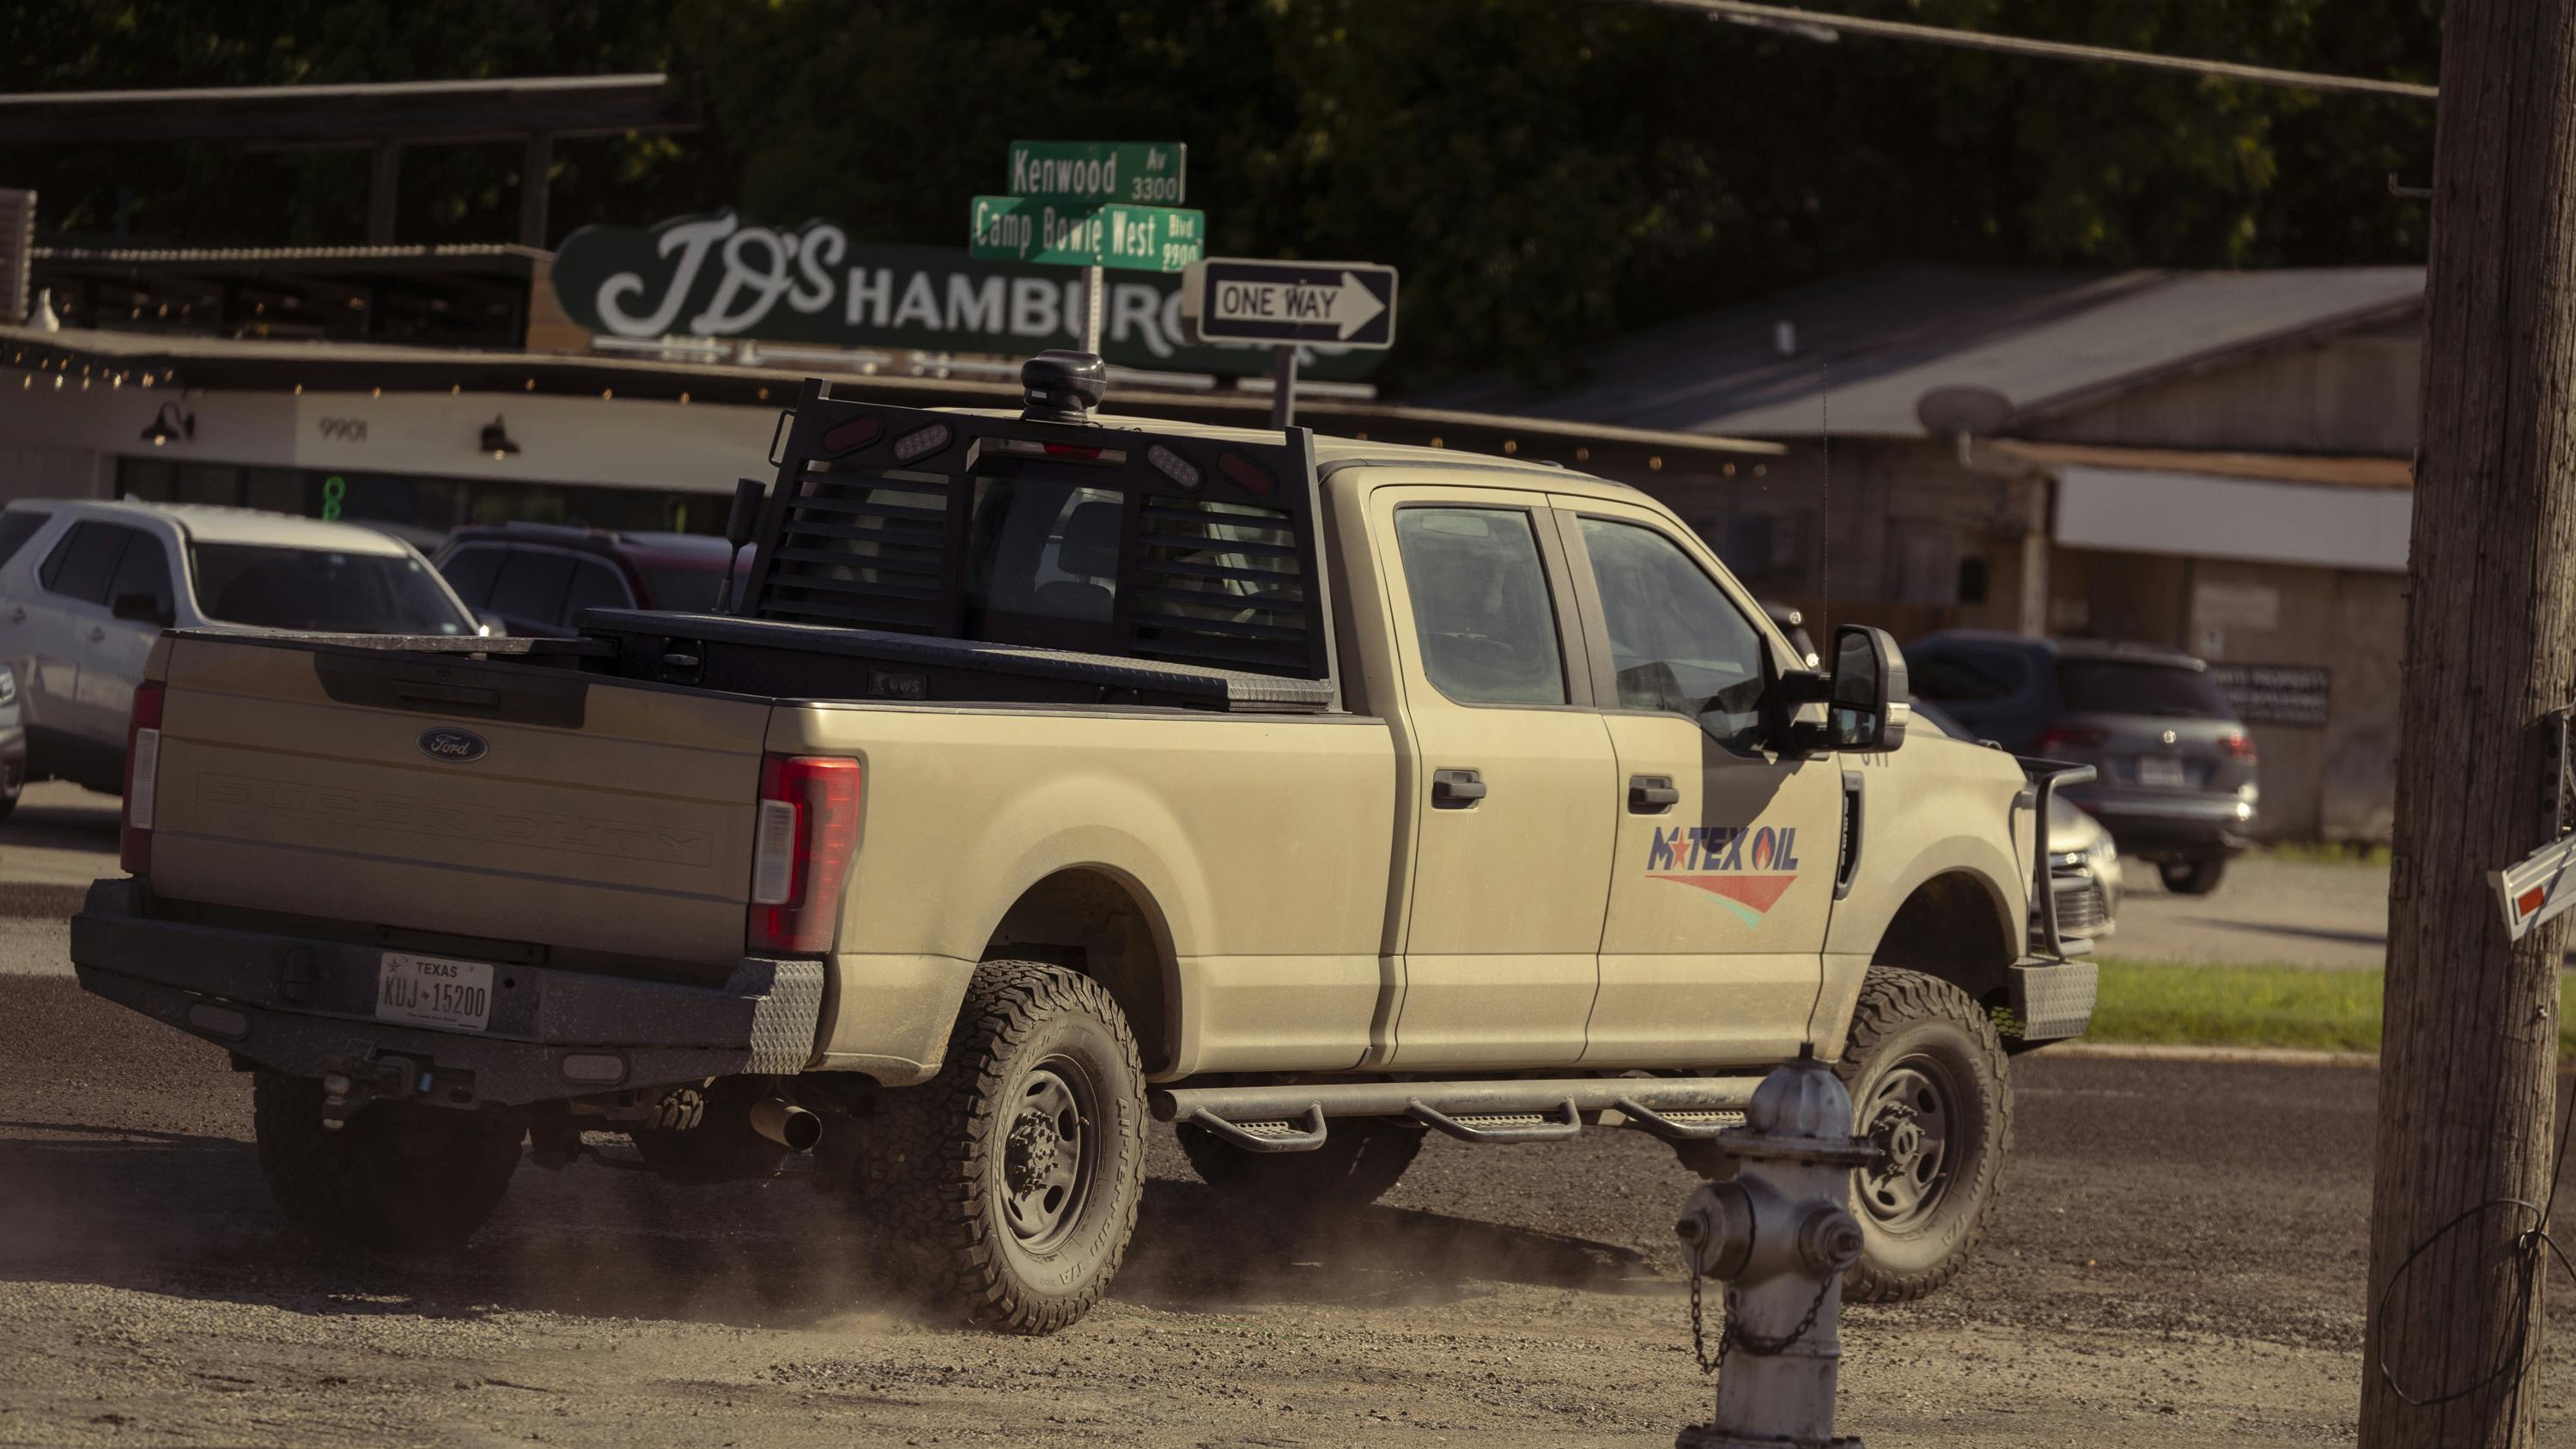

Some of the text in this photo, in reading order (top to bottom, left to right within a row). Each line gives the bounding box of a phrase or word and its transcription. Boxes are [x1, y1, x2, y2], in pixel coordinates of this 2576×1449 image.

[1013, 148, 1166, 194] Kenwood Av
[1132, 177, 1177, 200] 3300
[975, 201, 1194, 259] Camp Bowie West Blvd
[596, 210, 1353, 366] JD'S HAMBUR
[1224, 286, 1338, 320] ONE WAY
[319, 417, 368, 443] 9901
[431, 734, 471, 755] Ford
[204, 779, 702, 859] SUPER DUTY
[1752, 825, 1799, 870] OIL
[416, 962, 459, 977] TEXAS
[384, 977, 485, 1017] KUJ 15200
[1090, 1097, 1133, 1258] All-Terrain
